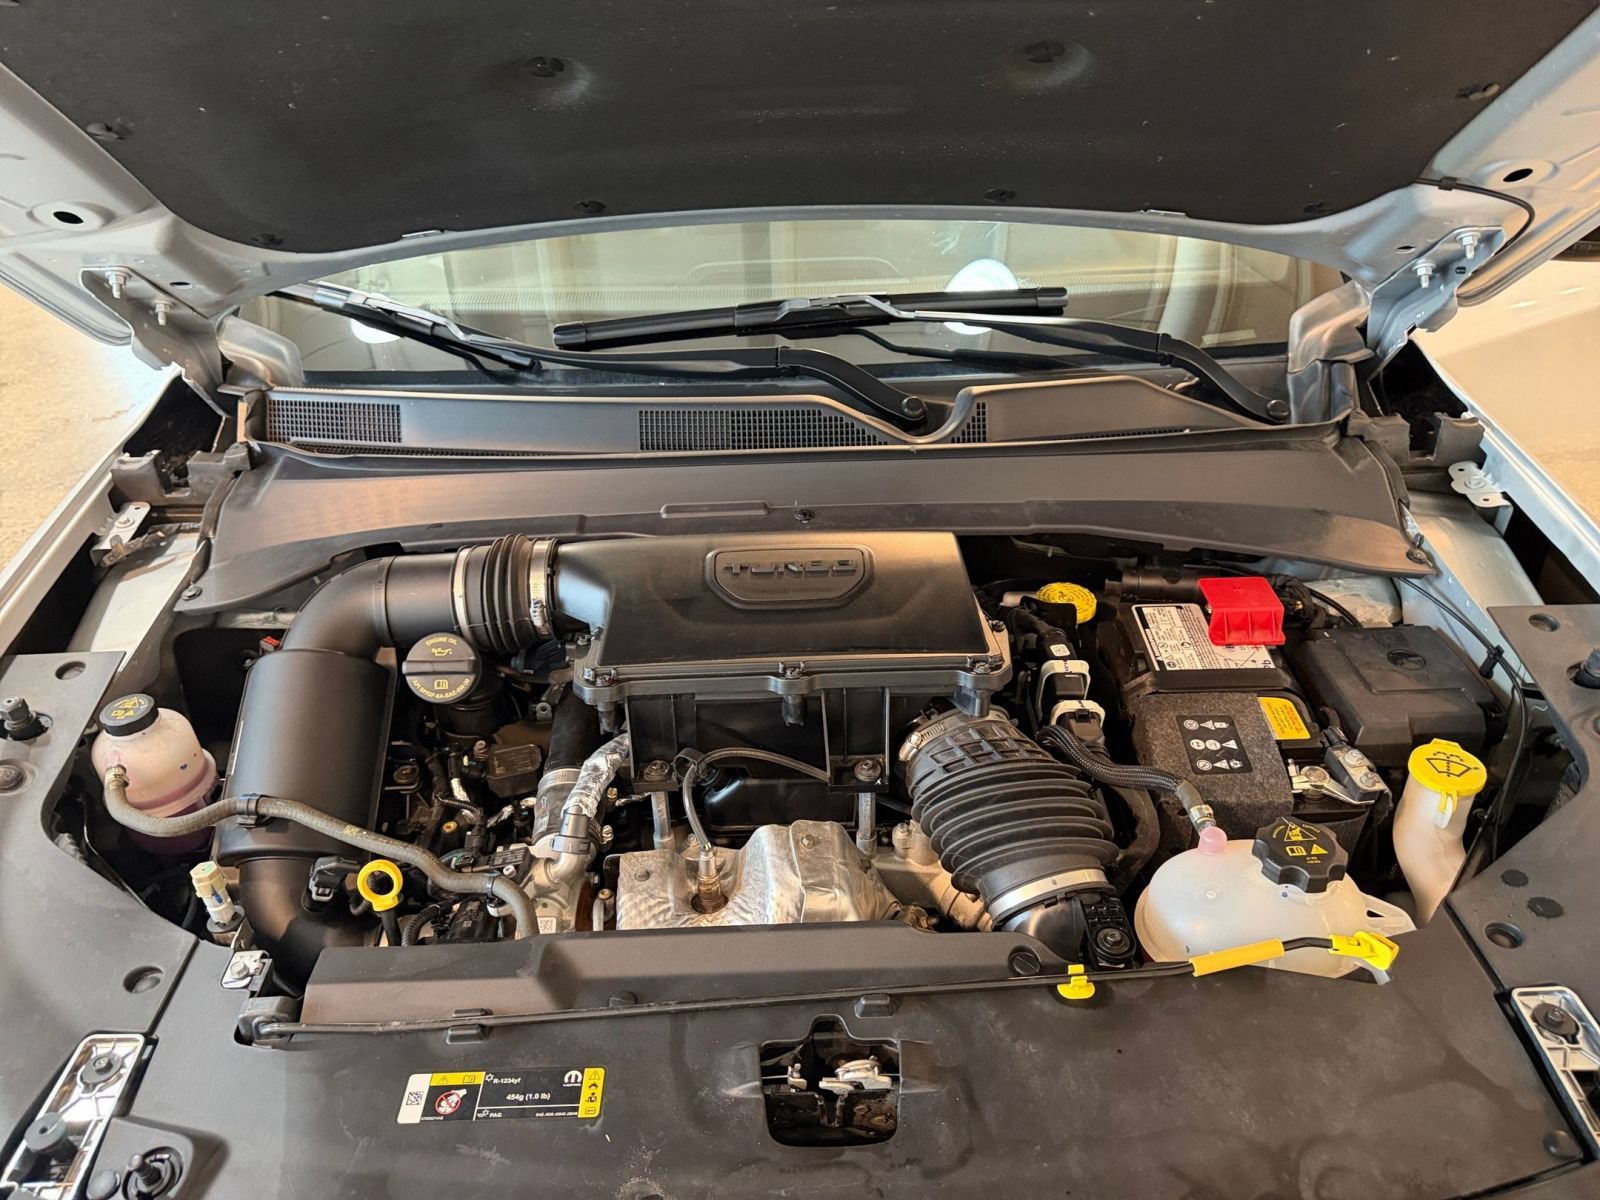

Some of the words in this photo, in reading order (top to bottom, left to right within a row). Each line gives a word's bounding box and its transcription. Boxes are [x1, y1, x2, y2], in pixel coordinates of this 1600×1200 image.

[724, 560, 857, 575] TURBO
[426, 637, 448, 646] ENGINE
[448, 638, 457, 646] OIL
[493, 1077, 522, 1085] R-1234yf
[506, 1093, 525, 1102] 454g
[525, 1093, 540, 1101] (1.0
[540, 1092, 551, 1101] lb)
